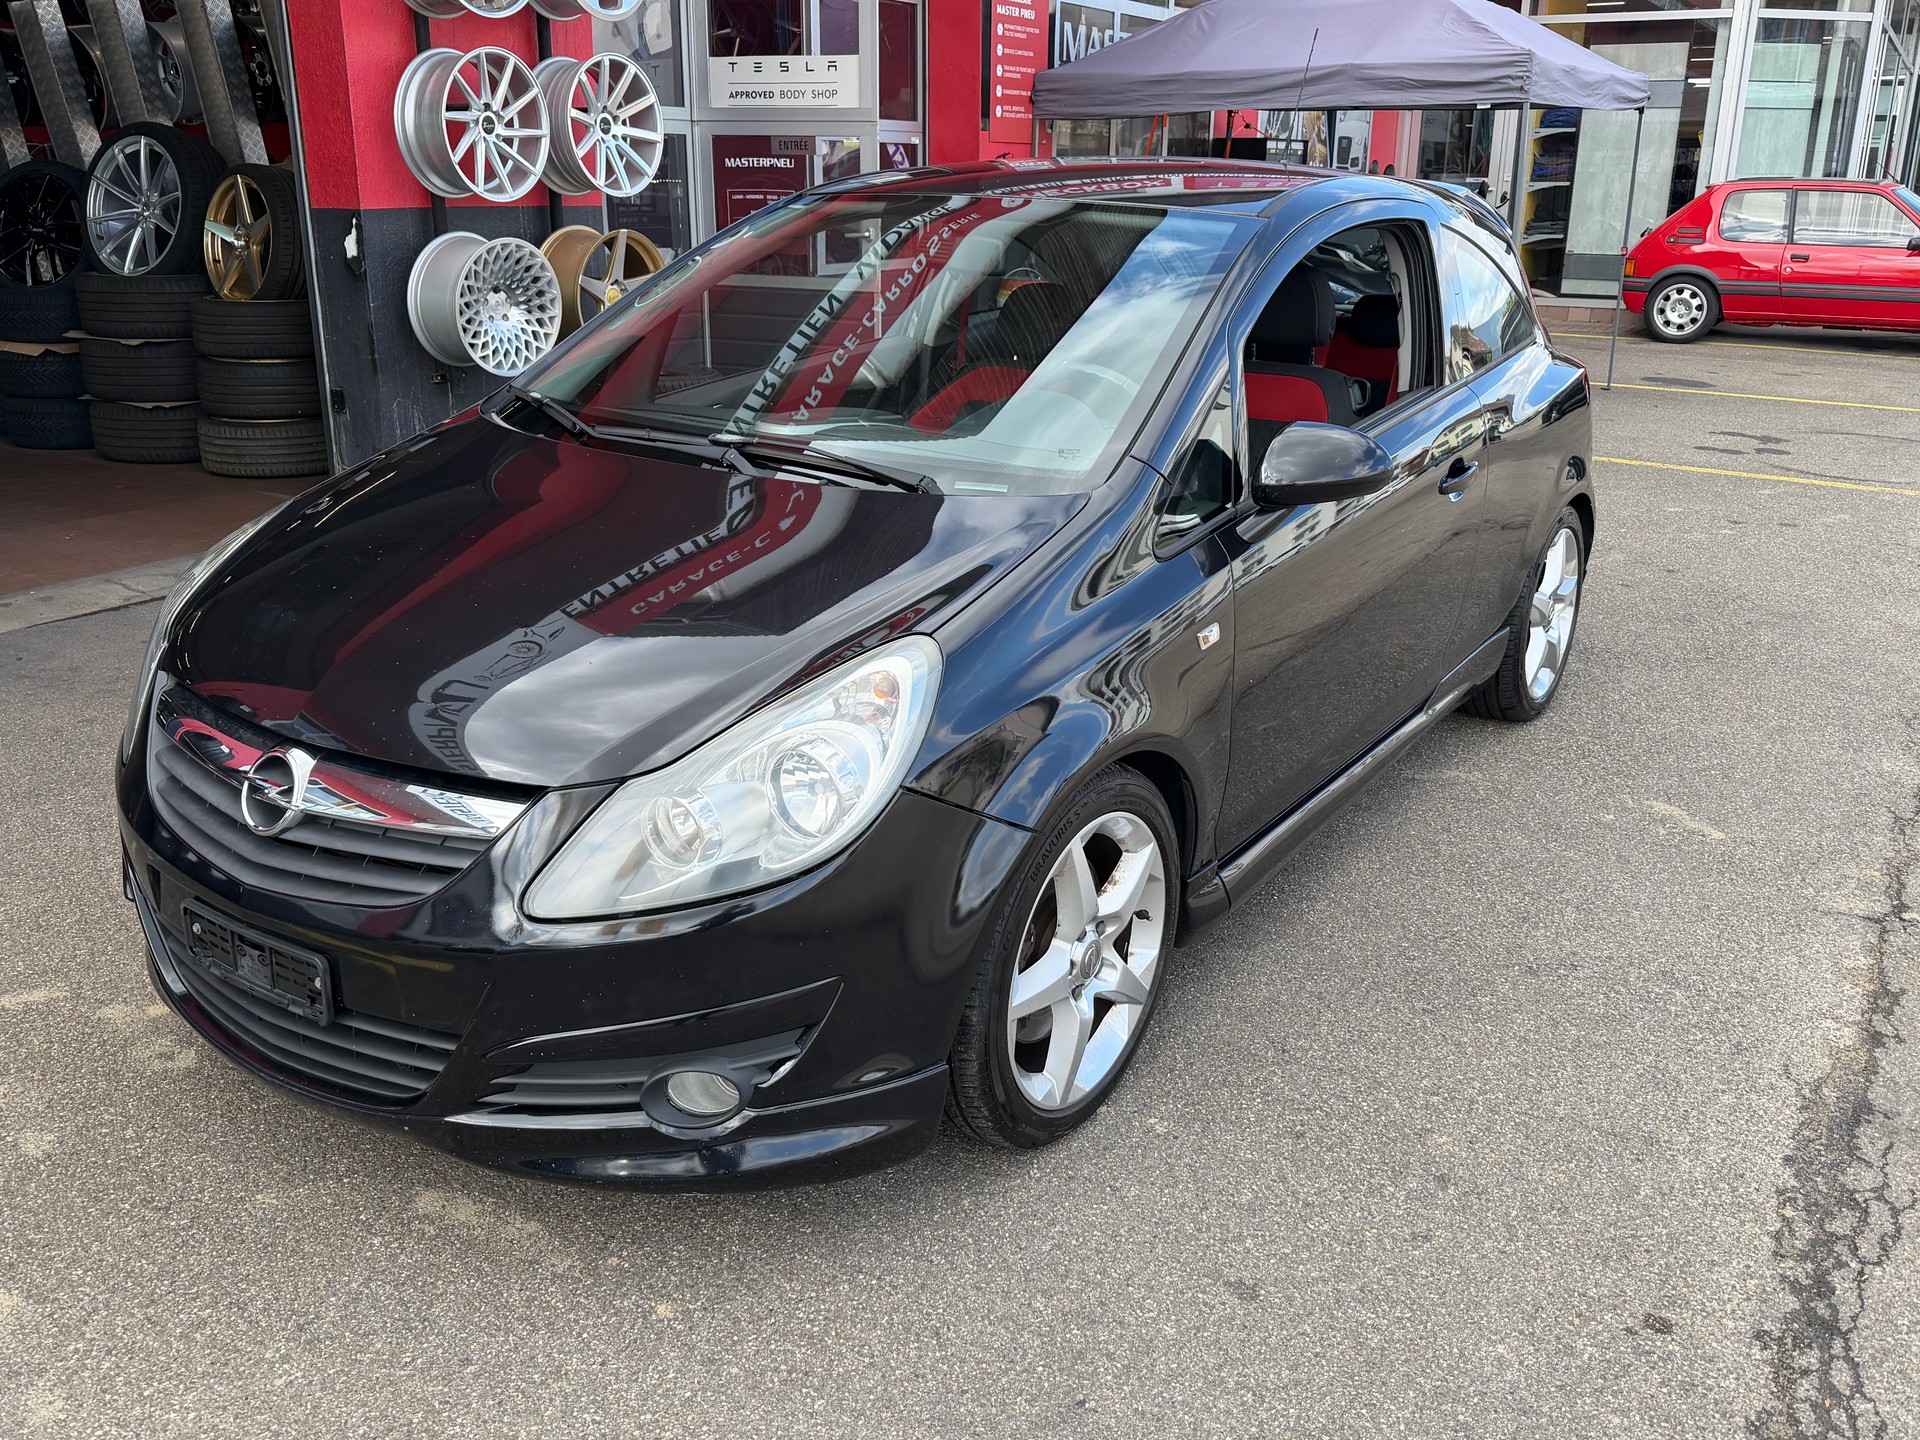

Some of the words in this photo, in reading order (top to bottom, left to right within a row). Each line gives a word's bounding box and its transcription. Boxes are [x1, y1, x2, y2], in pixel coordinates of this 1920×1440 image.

[997, 4, 1019, 17] MASTER
[1020, 8, 1035, 20] PNEU
[728, 60, 838, 73] TESLA
[728, 90, 775, 99] APPROVED
[779, 89, 807, 99] BODY
[811, 89, 838, 99] SHOP
[778, 138, 809, 151] ENTRÉE
[724, 156, 795, 169] MASTERPNEU
[1029, 816, 1074, 883] BRAVURIS
[1075, 809, 1082, 820] 5
